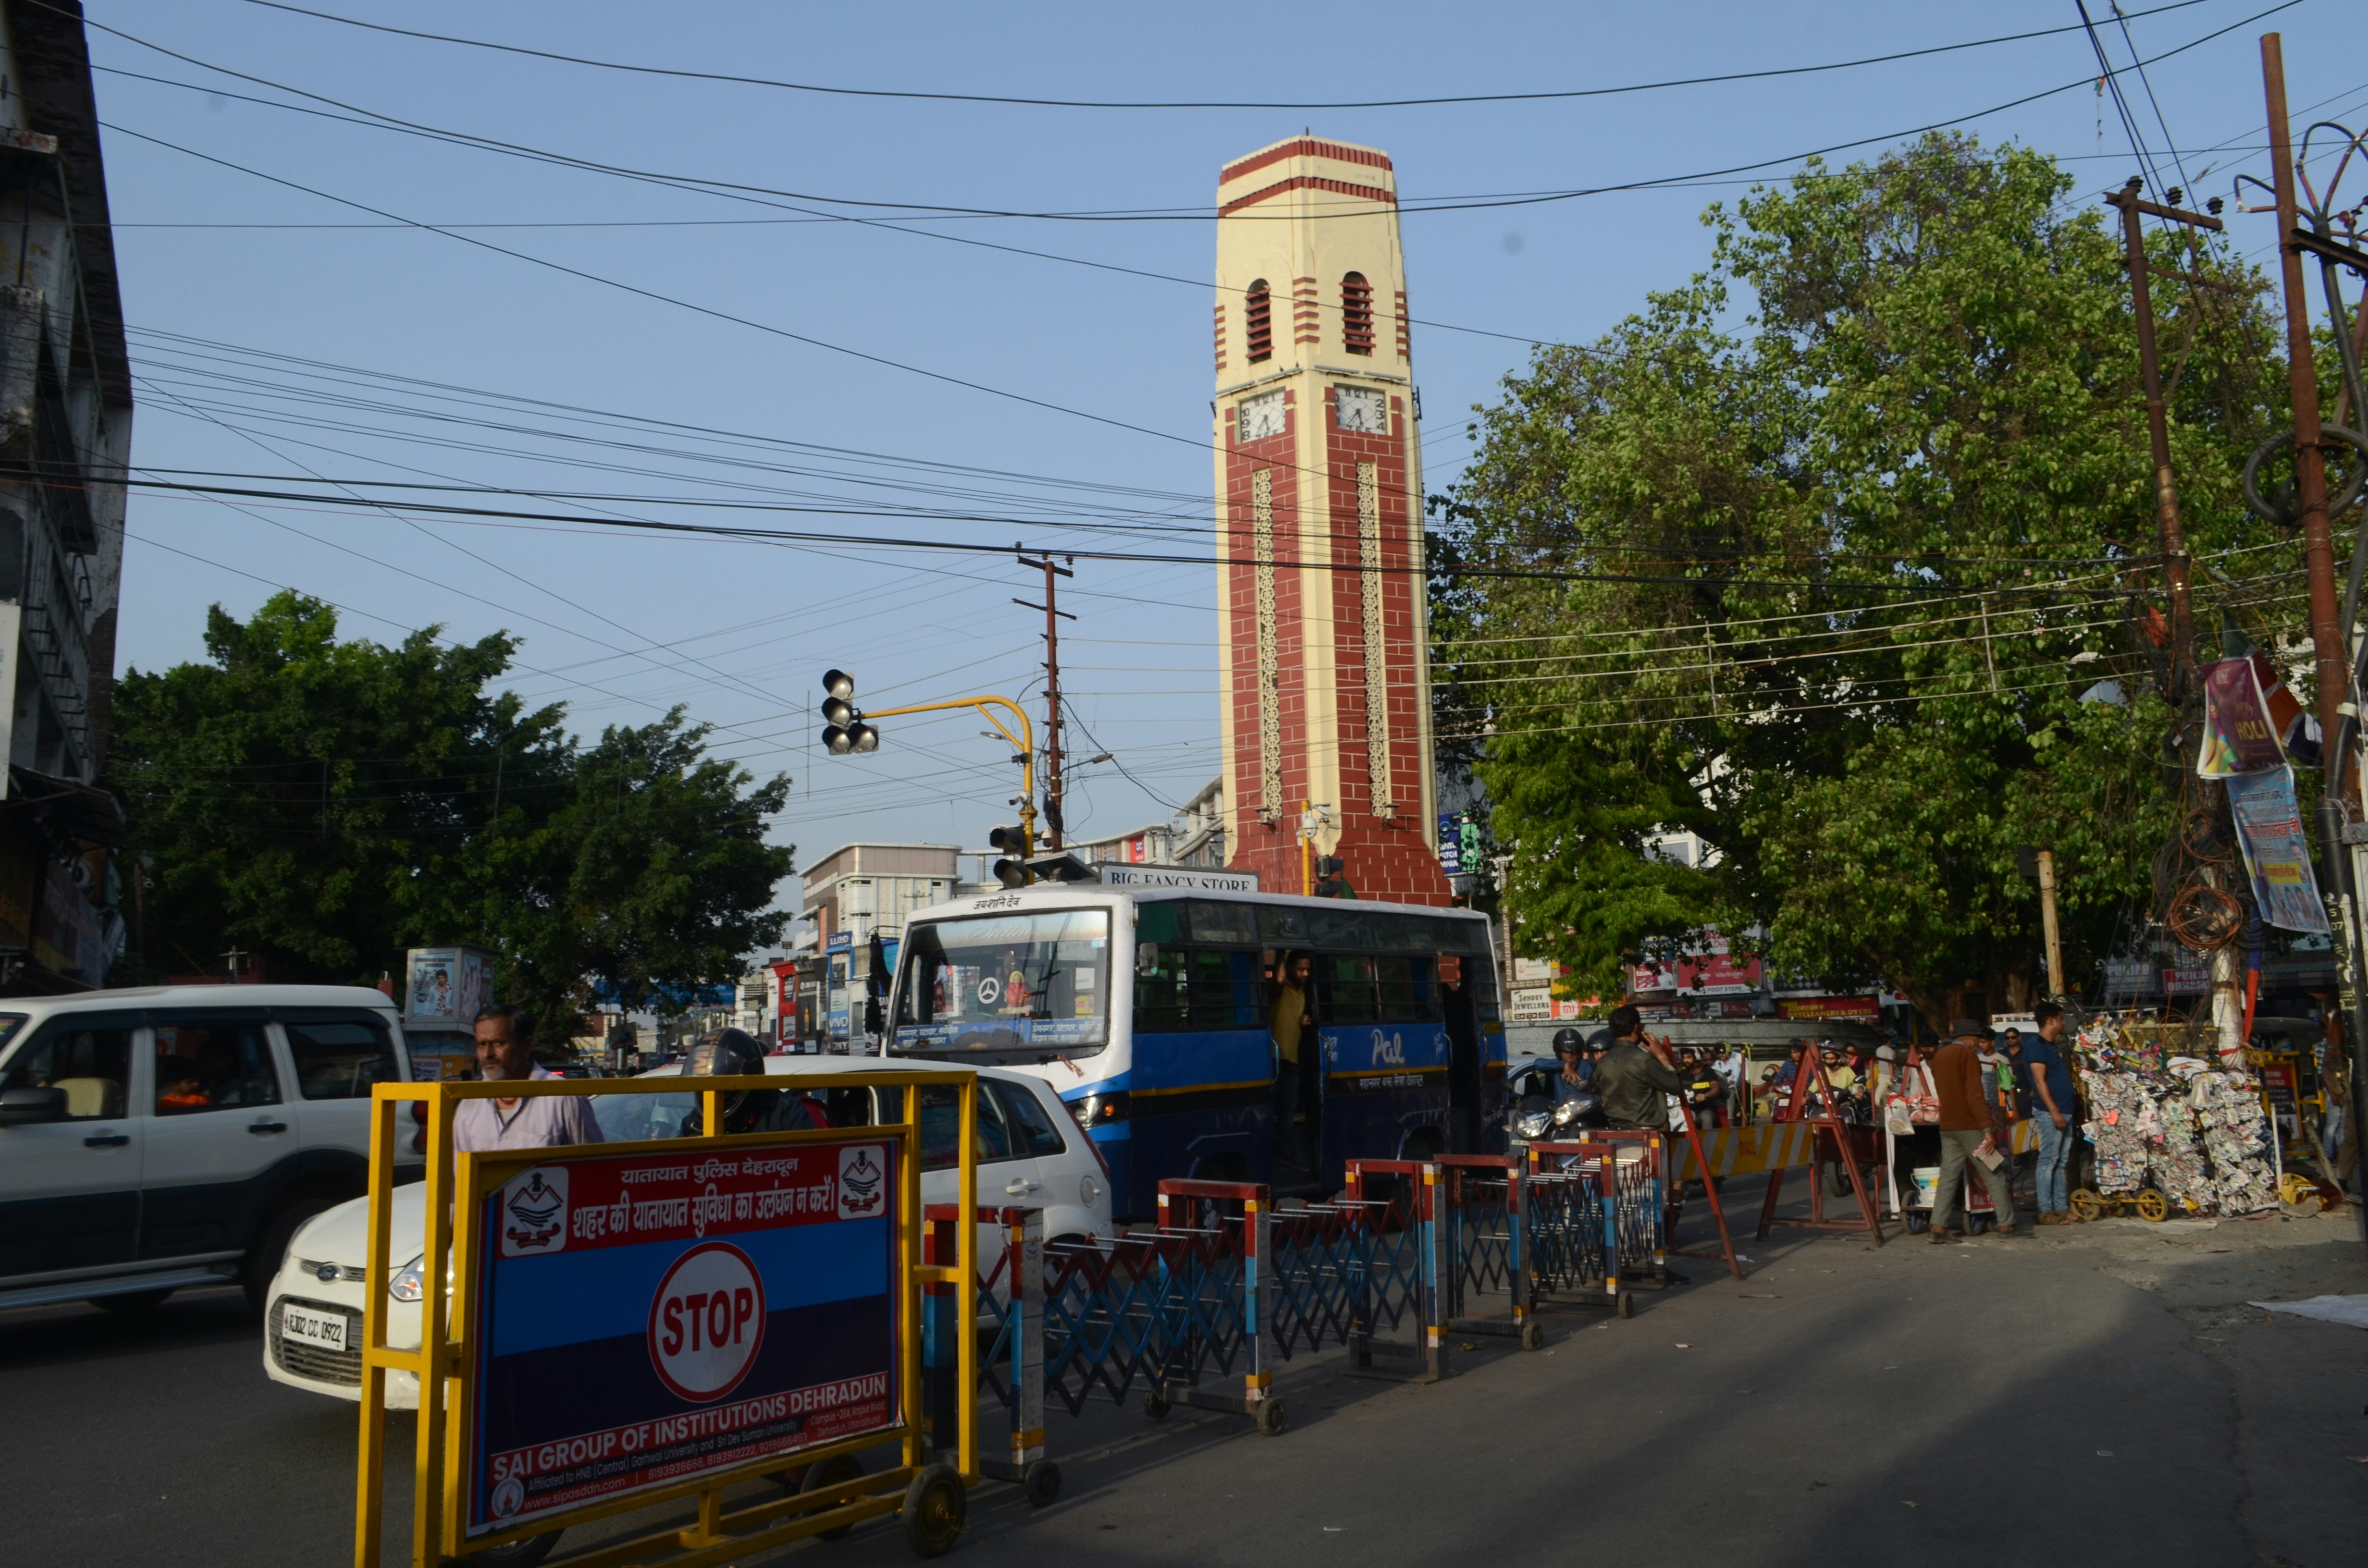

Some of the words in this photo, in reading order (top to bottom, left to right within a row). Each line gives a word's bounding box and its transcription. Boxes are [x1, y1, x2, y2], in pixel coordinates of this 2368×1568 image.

[1376, 399, 1384, 407] 2
[1376, 409, 1385, 420] 3
[1242, 418, 1250, 429] 9
[1242, 430, 1250, 441] 8
[1376, 422, 1385, 431] 4
[2235, 719, 2269, 740] HOLI
[1110, 872, 1137, 884] BIG
[1145, 874, 1196, 887] FANCY
[1201, 878, 1250, 891] STORE
[620, 1165, 689, 1184] यातायात
[692, 1157, 739, 1184] पुलिस
[741, 1156, 800, 1177] देहरादून
[573, 1203, 609, 1240] शहर
[609, 1189, 631, 1234] की
[632, 1197, 691, 1232] यातायात
[691, 1182, 733, 1238] सुविधा
[735, 1192, 754, 1224] का
[755, 1178, 795, 1220] उलंघन
[796, 1187, 808, 1214] न
[289, 1314, 307, 1335] RJ02
[308, 1319, 319, 1337] CC
[321, 1322, 342, 1343] 0922
[662, 1287, 752, 1357] STOP
[493, 1450, 532, 1482] SAI
[538, 1432, 617, 1471] GROUP
[620, 1424, 651, 1452] OF
[654, 1396, 787, 1446] INSTITUTIONS
[790, 1374, 886, 1415] DEHRADUN
[528, 1473, 565, 1493] Affiliated
[565, 1471, 574, 1484] to
[575, 1467, 592, 1482] HNB
[593, 1455, 630, 1480] (Central)
[630, 1448, 664, 1468] Garhwal
[664, 1440, 699, 1460] University
[700, 1436, 715, 1451] and
[716, 1433, 727, 1448] Sri
[728, 1432, 741, 1446] Dev
[741, 1427, 766, 1444] Suman
[766, 1419, 798, 1438] University
[523, 1476, 626, 1511] www.sipasddn.com
[647, 1458, 705, 1481] 8193936666,
[707, 1444, 758, 1466] 8193912222,
